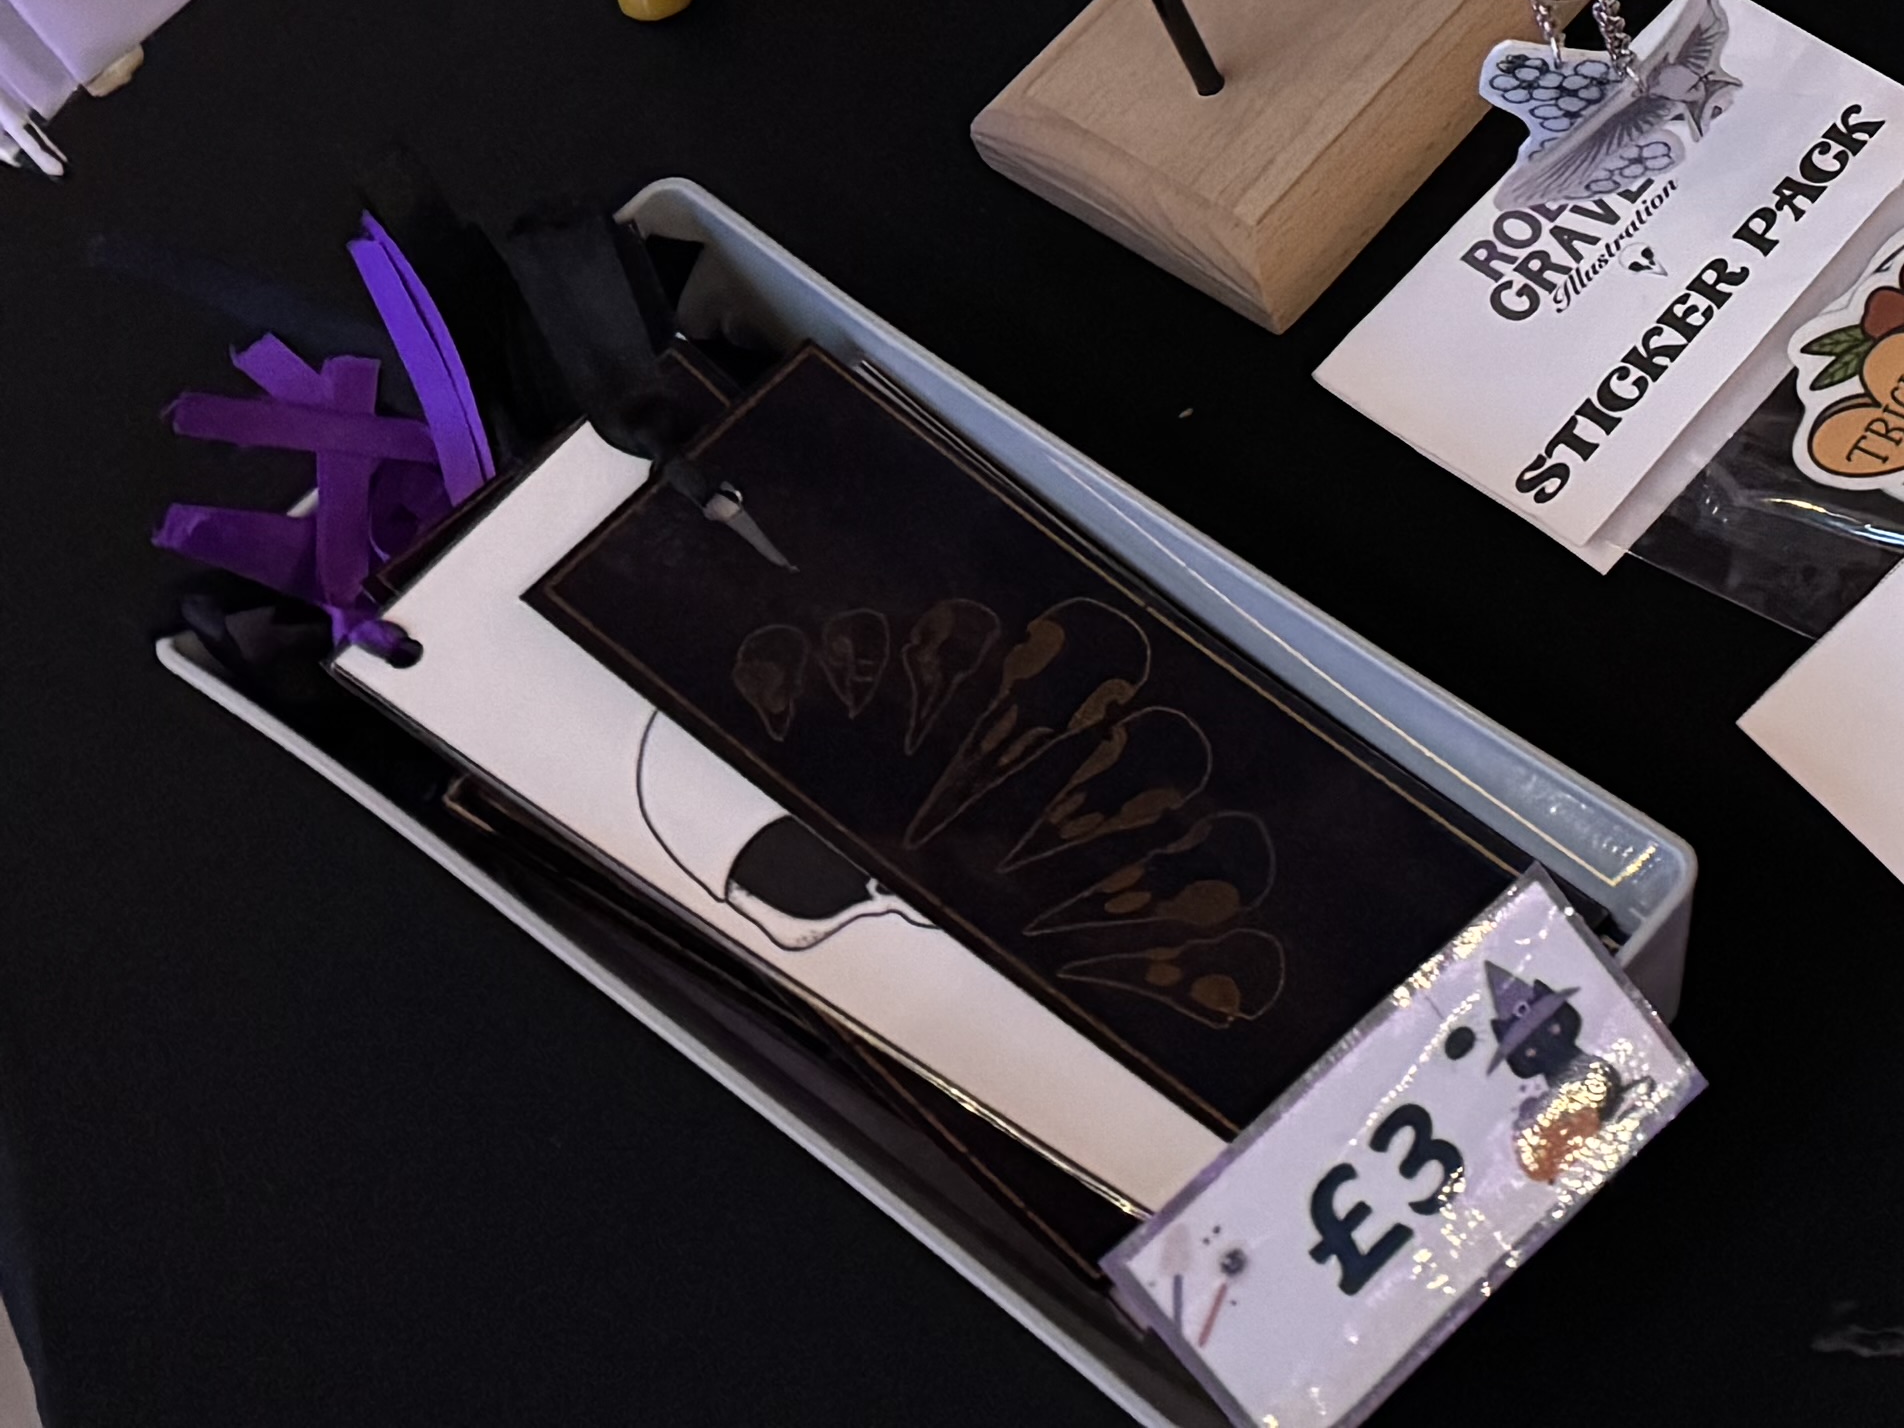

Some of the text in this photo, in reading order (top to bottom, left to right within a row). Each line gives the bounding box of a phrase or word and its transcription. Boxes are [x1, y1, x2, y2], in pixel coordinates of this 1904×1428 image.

[1514, 253, 1752, 505] STICKER
[1734, 105, 1886, 256] PACK
[1553, 177, 1680, 314] Illustration
[1308, 1102, 1466, 1297] £3
